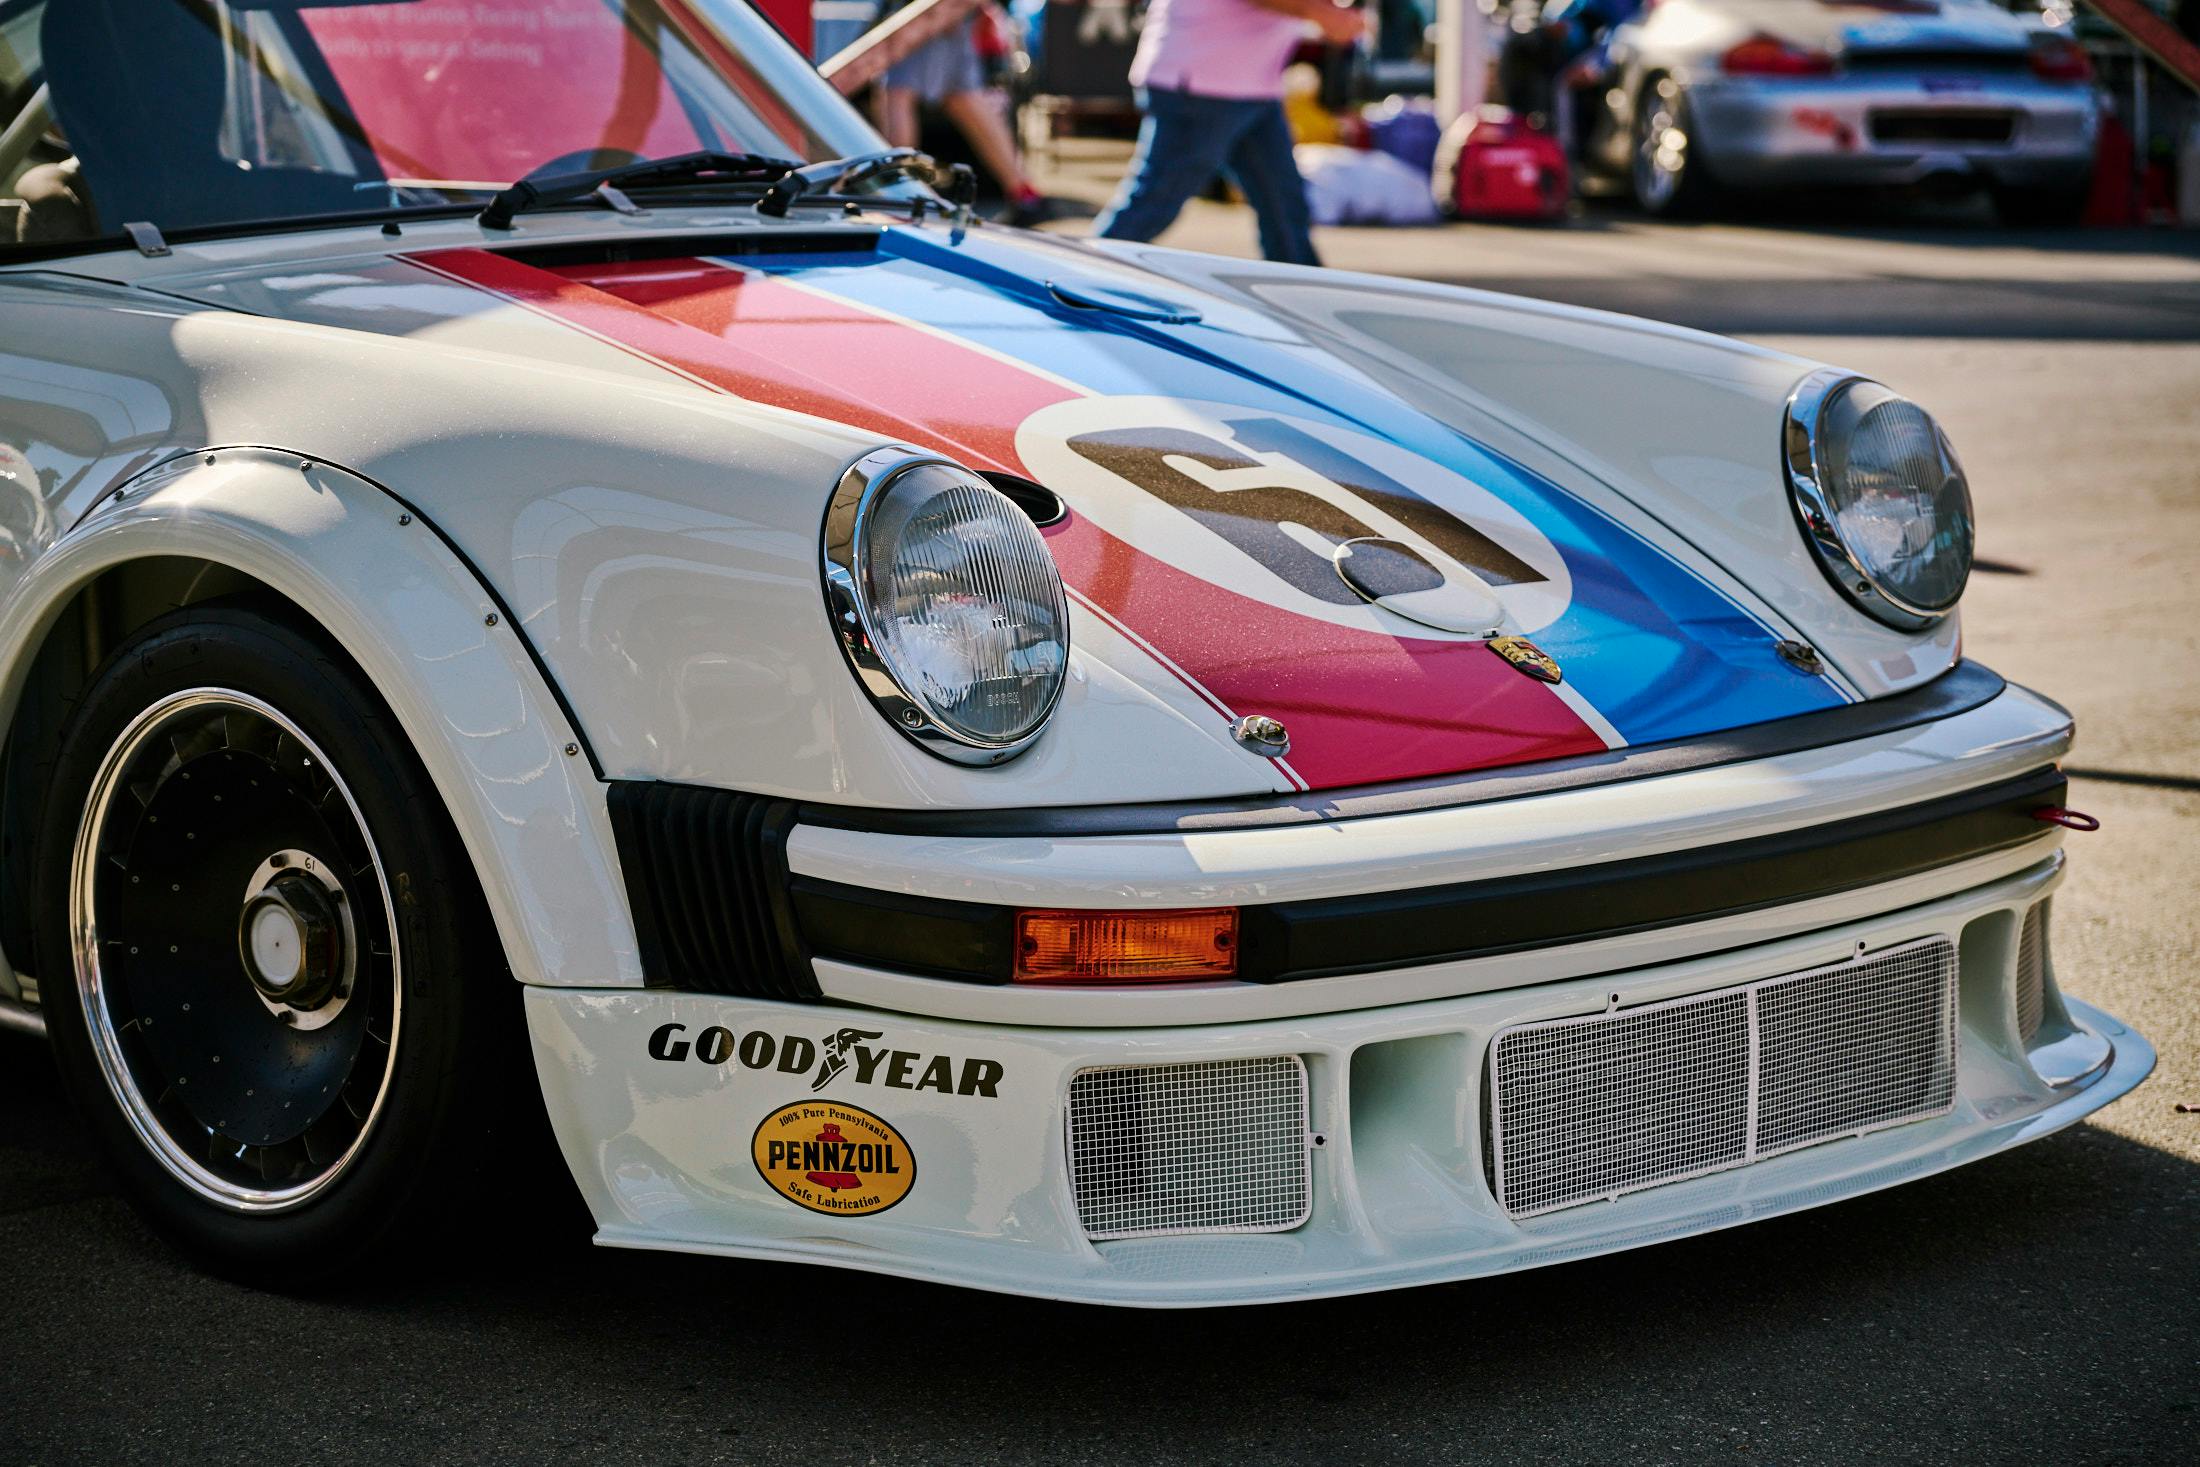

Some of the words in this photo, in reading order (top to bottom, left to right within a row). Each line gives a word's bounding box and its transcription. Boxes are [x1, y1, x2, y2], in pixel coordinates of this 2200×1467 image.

[1066, 417, 1550, 605] 61
[305, 857, 316, 871] 61
[779, 1111, 800, 1127] 100%
[803, 1108, 825, 1119] Pure
[829, 1107, 889, 1141] Pennsylvania
[768, 1140, 900, 1174] PENNZOIL
[788, 1181, 812, 1201] Safe
[816, 1194, 881, 1210] Lubrication
